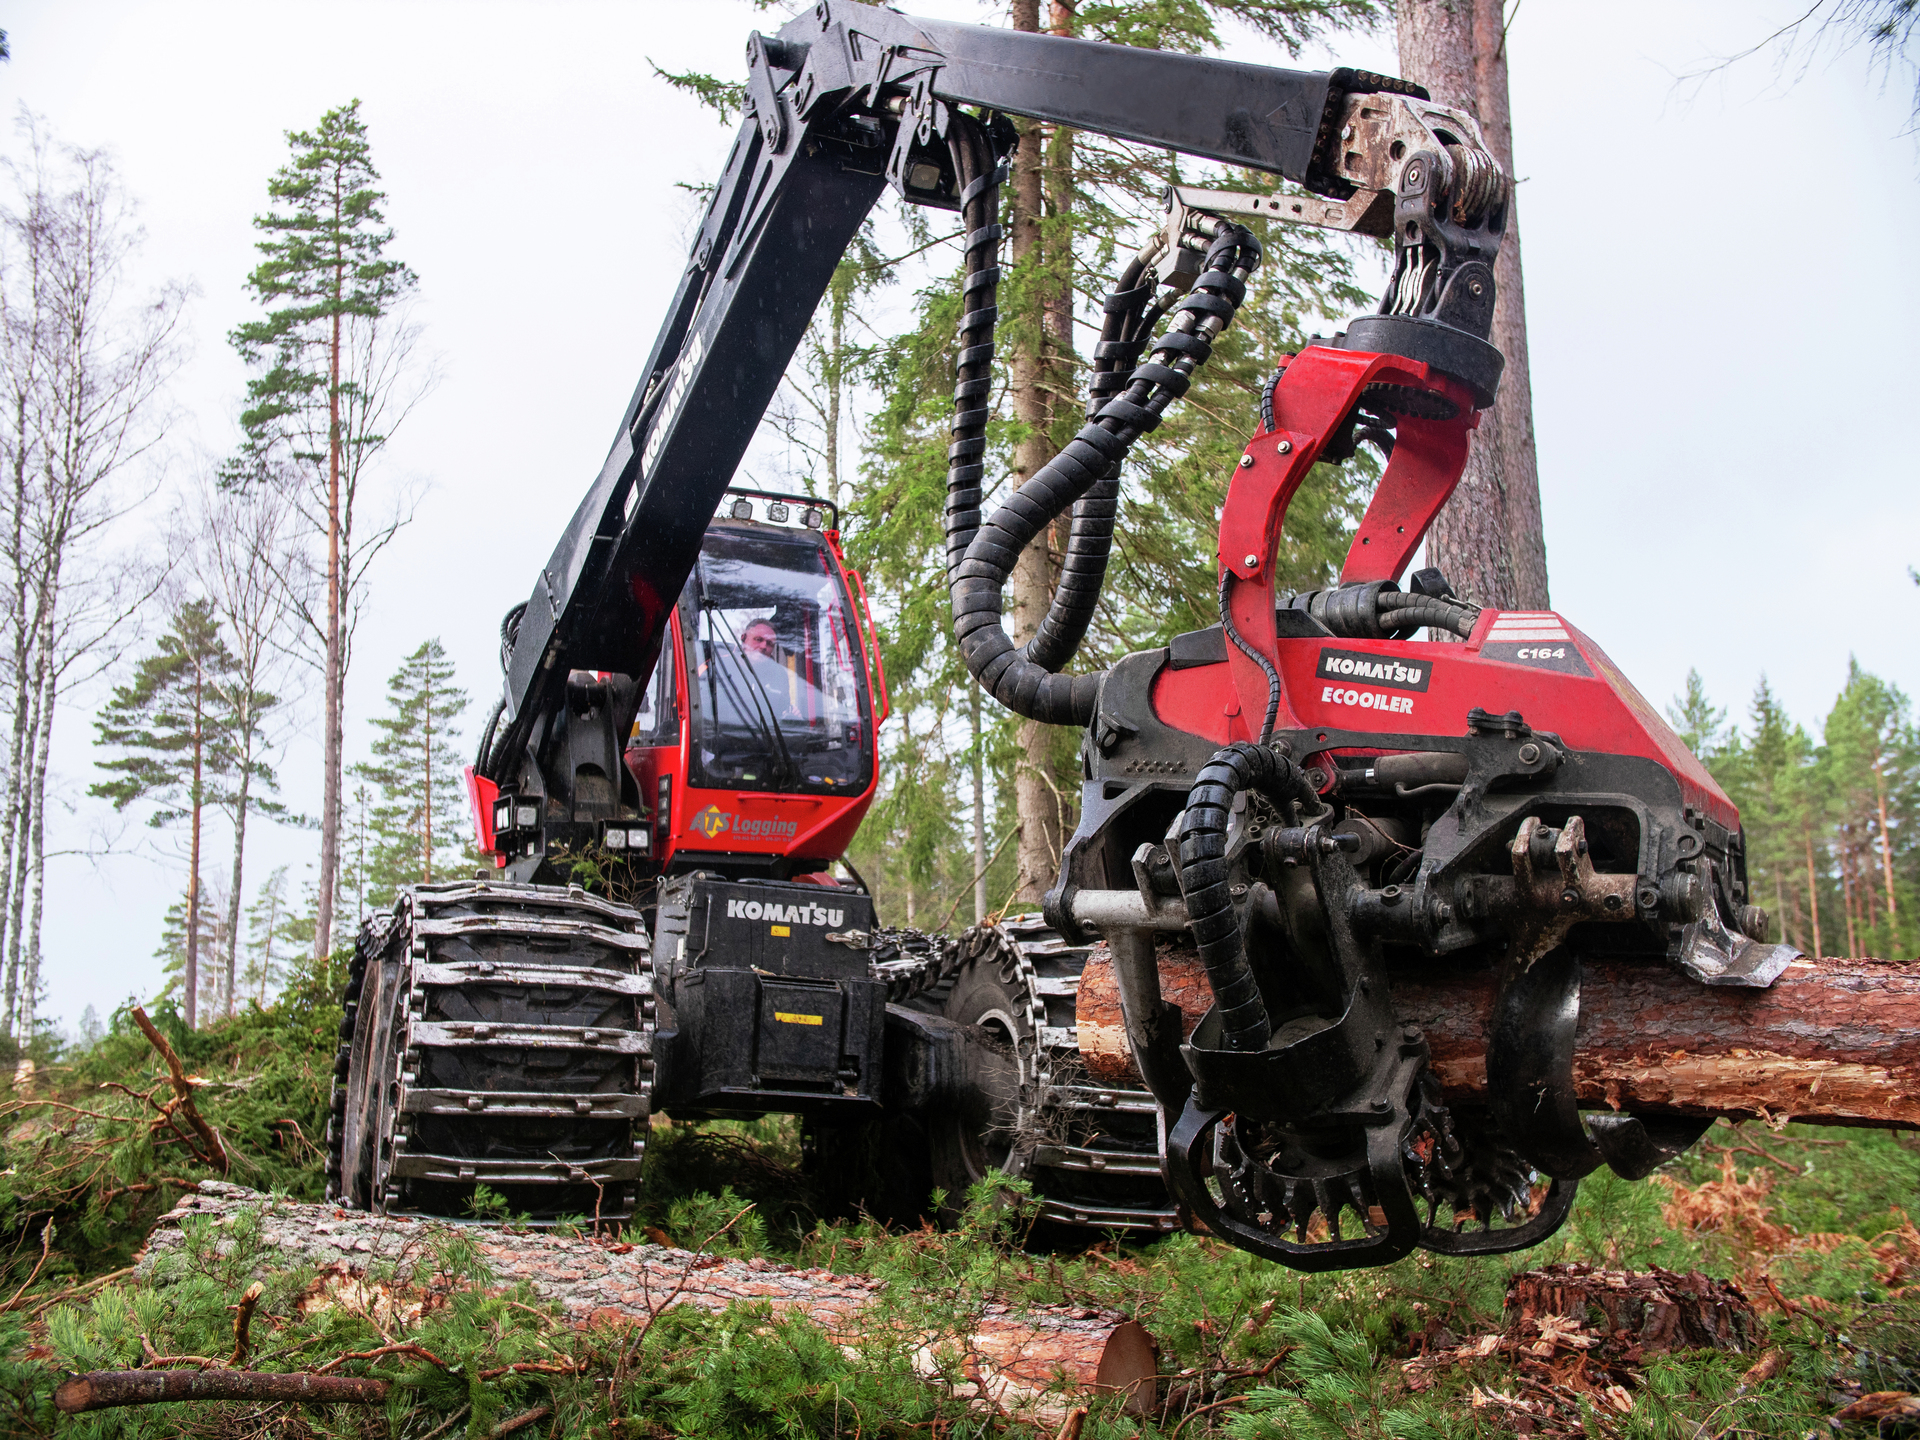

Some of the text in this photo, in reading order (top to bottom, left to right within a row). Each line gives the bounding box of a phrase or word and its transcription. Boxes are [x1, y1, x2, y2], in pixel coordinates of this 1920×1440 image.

[641, 331, 702, 480] KOMATSU
[1517, 647, 1566, 660] C164
[1325, 656, 1422, 685] KOMATSU
[1321, 686, 1414, 715] ECOOILER
[689, 811, 798, 837] ATS Logging
[727, 899, 844, 928] KOMATSU
